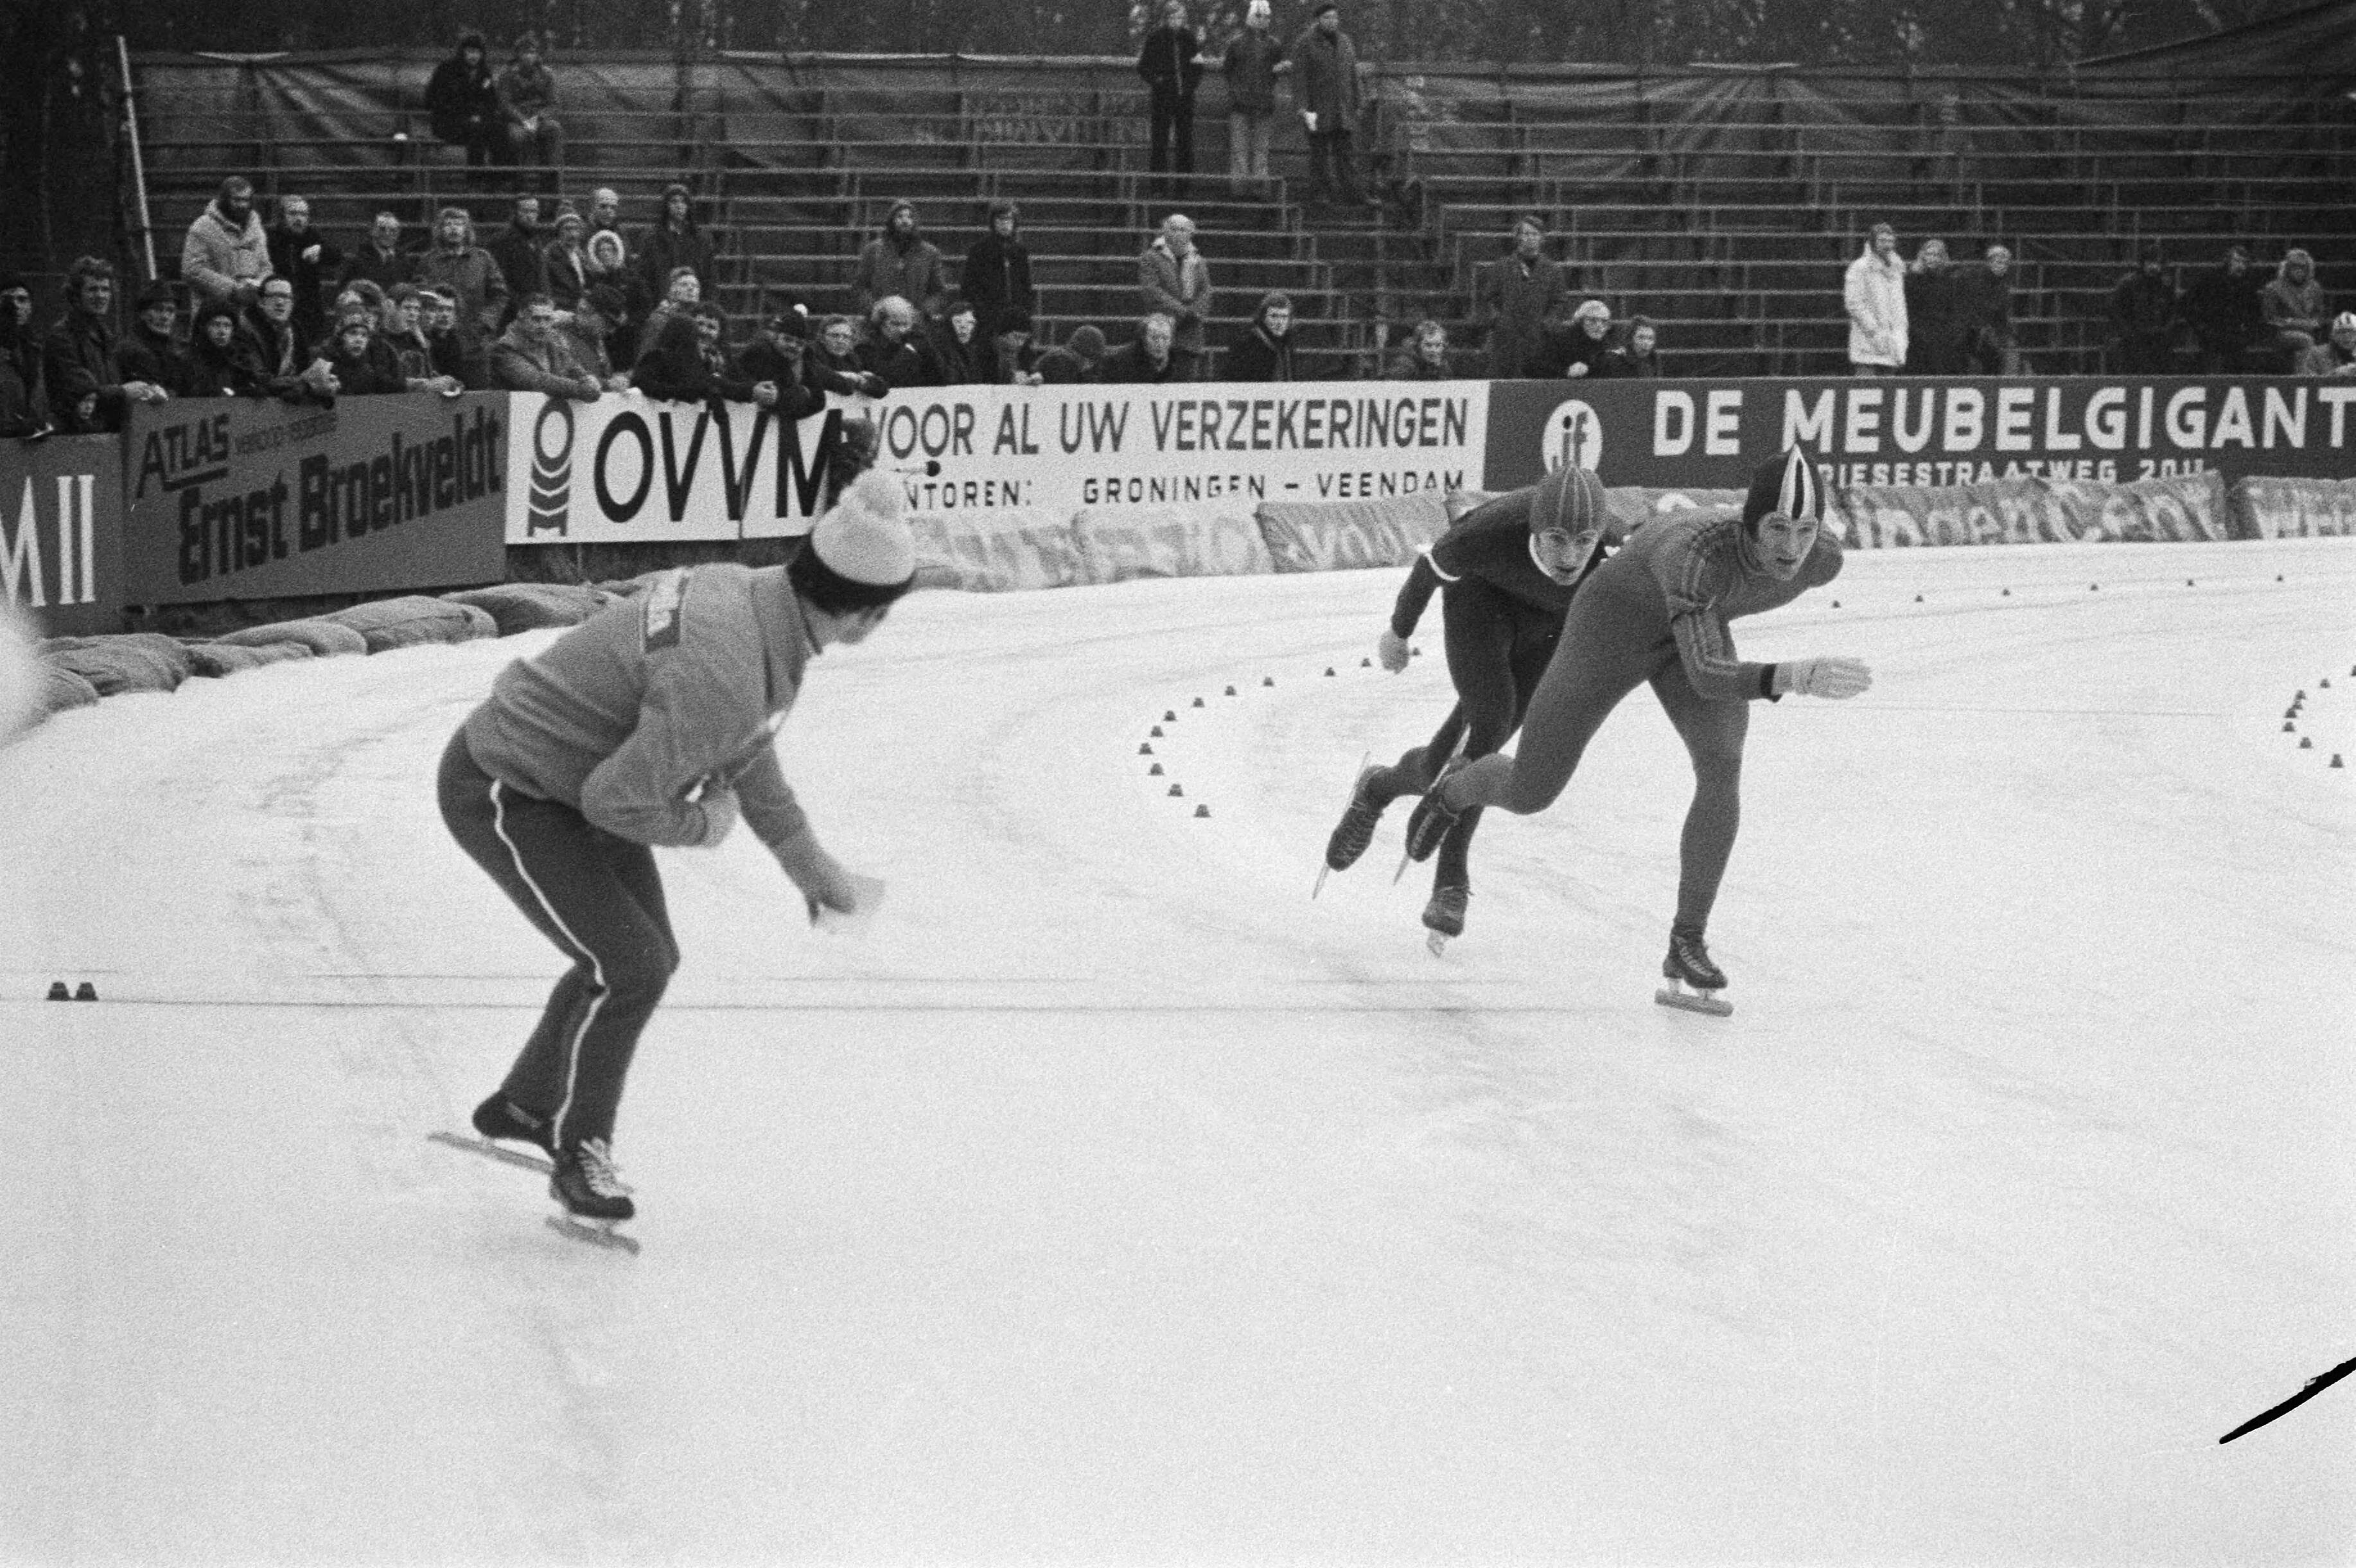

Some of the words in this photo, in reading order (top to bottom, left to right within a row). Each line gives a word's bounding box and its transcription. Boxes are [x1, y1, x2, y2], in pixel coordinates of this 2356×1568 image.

[135, 413, 230, 498] ATLAS
[863, 402, 976, 460] VOOR
[993, 401, 1040, 455] AL
[1060, 400, 1130, 455] UW
[1152, 397, 1468, 452] VERZEKERINGEN
[1653, 389, 1743, 456] DE
[1782, 386, 2356, 454] MEUBELGIGANT
[178, 471, 288, 586] Ernst
[298, 405, 502, 552] Broekveldt
[593, 408, 843, 524] OVVM
[1083, 474, 1266, 504] GRONINGEN
[1317, 470, 1464, 498] VEENDAM
